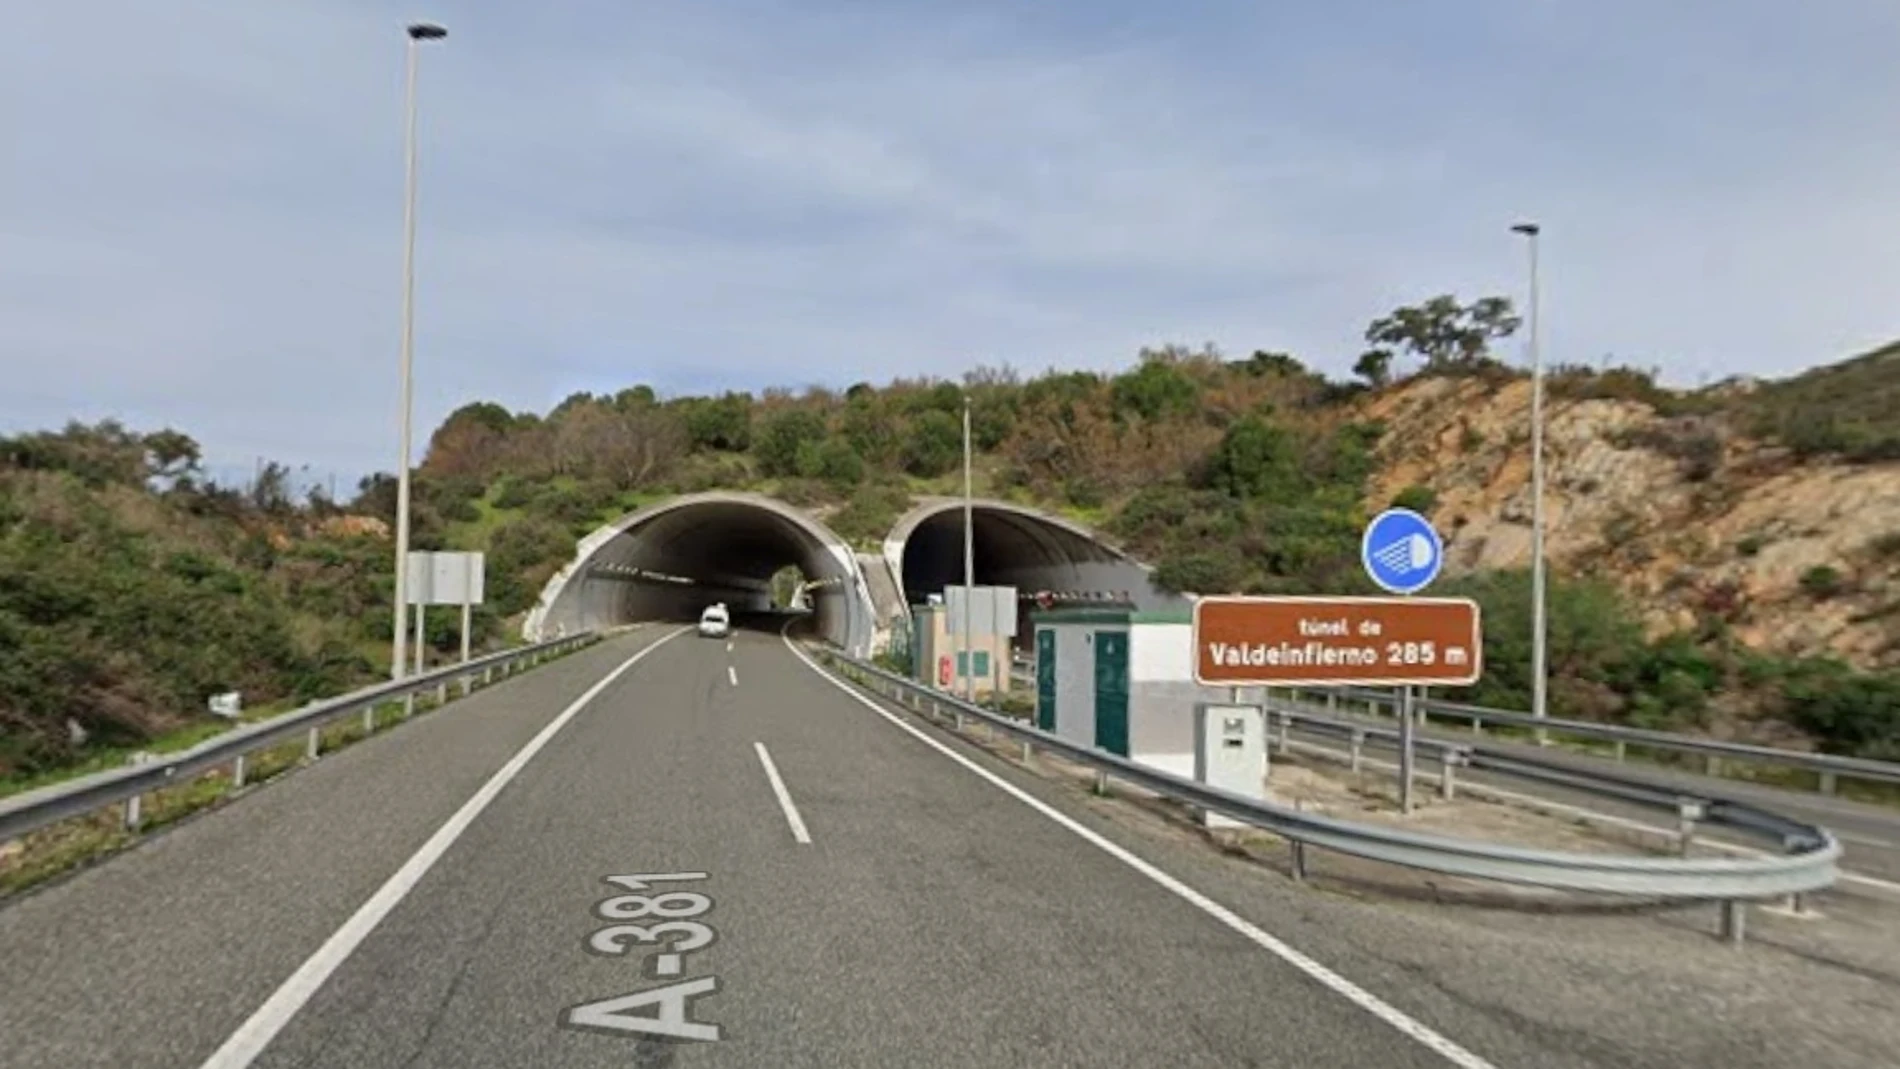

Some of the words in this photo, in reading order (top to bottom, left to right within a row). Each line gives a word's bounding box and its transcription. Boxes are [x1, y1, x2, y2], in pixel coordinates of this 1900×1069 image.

[1298, 617, 1348, 636] túnel
[1359, 618, 1382, 636] de
[1209, 642, 1379, 666] Valdeinfierno
[1386, 641, 1436, 665] 285
[1444, 646, 1468, 665] m
